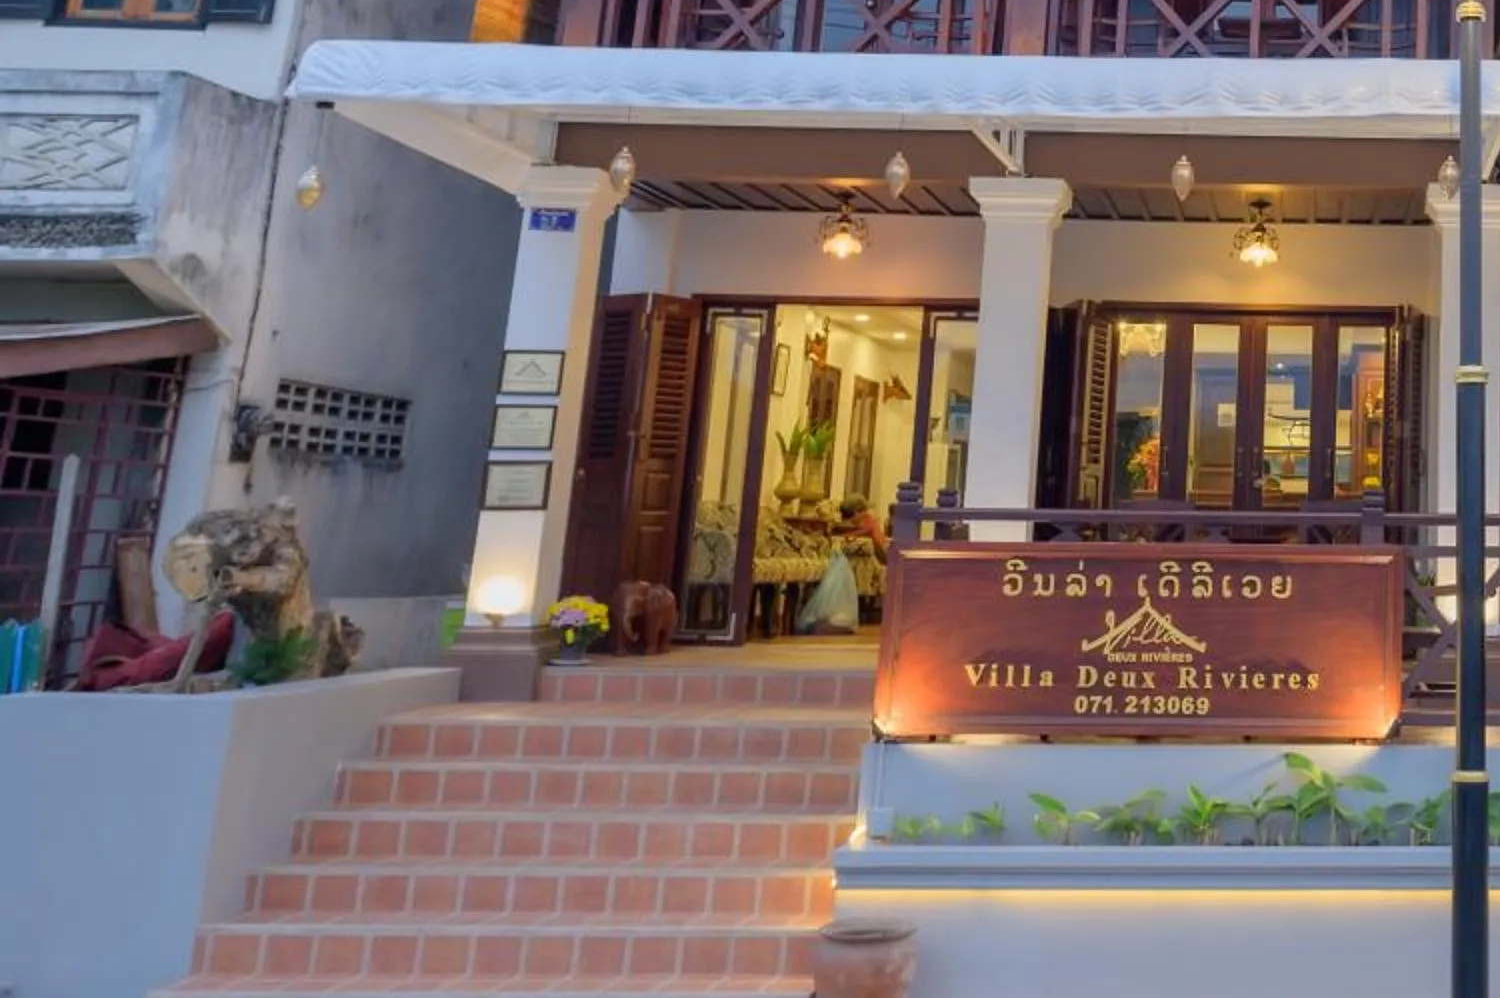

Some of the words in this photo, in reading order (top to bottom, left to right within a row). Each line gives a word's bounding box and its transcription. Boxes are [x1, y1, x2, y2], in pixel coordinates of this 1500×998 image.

[964, 663, 1055, 689] Villa
[1076, 664, 1157, 690] Deux
[1177, 664, 1321, 692] Rivieres
[1124, 695, 1212, 716] 213069
